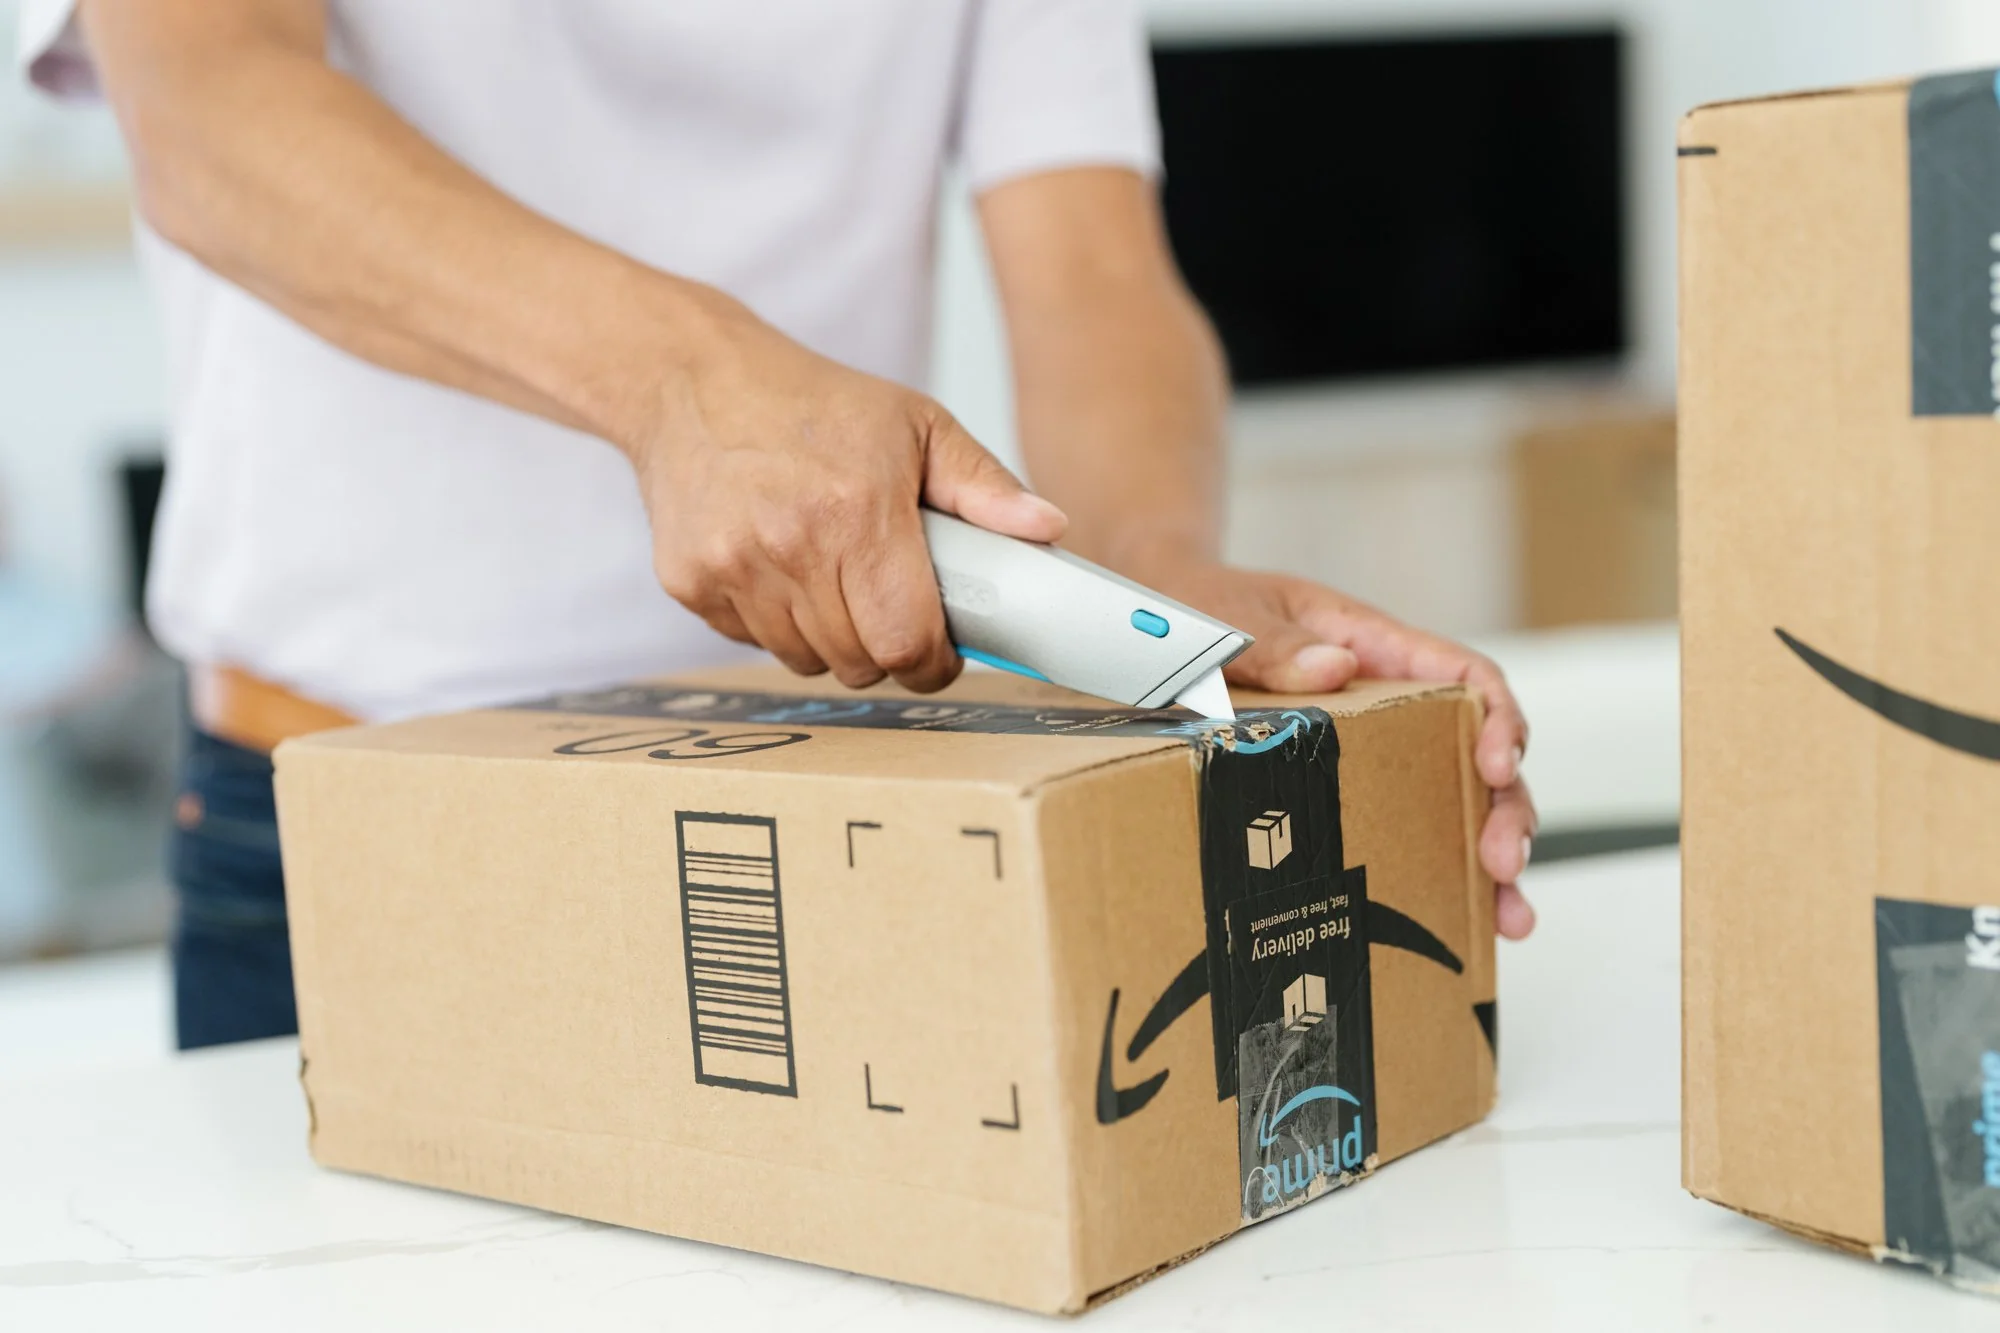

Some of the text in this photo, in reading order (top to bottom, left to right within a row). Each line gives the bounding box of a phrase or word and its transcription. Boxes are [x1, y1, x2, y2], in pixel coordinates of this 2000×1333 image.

[1250, 893, 1349, 934] fast, free & convenient
[1251, 916, 1351, 962] free delivery
[1262, 1115, 1362, 1203] prime
